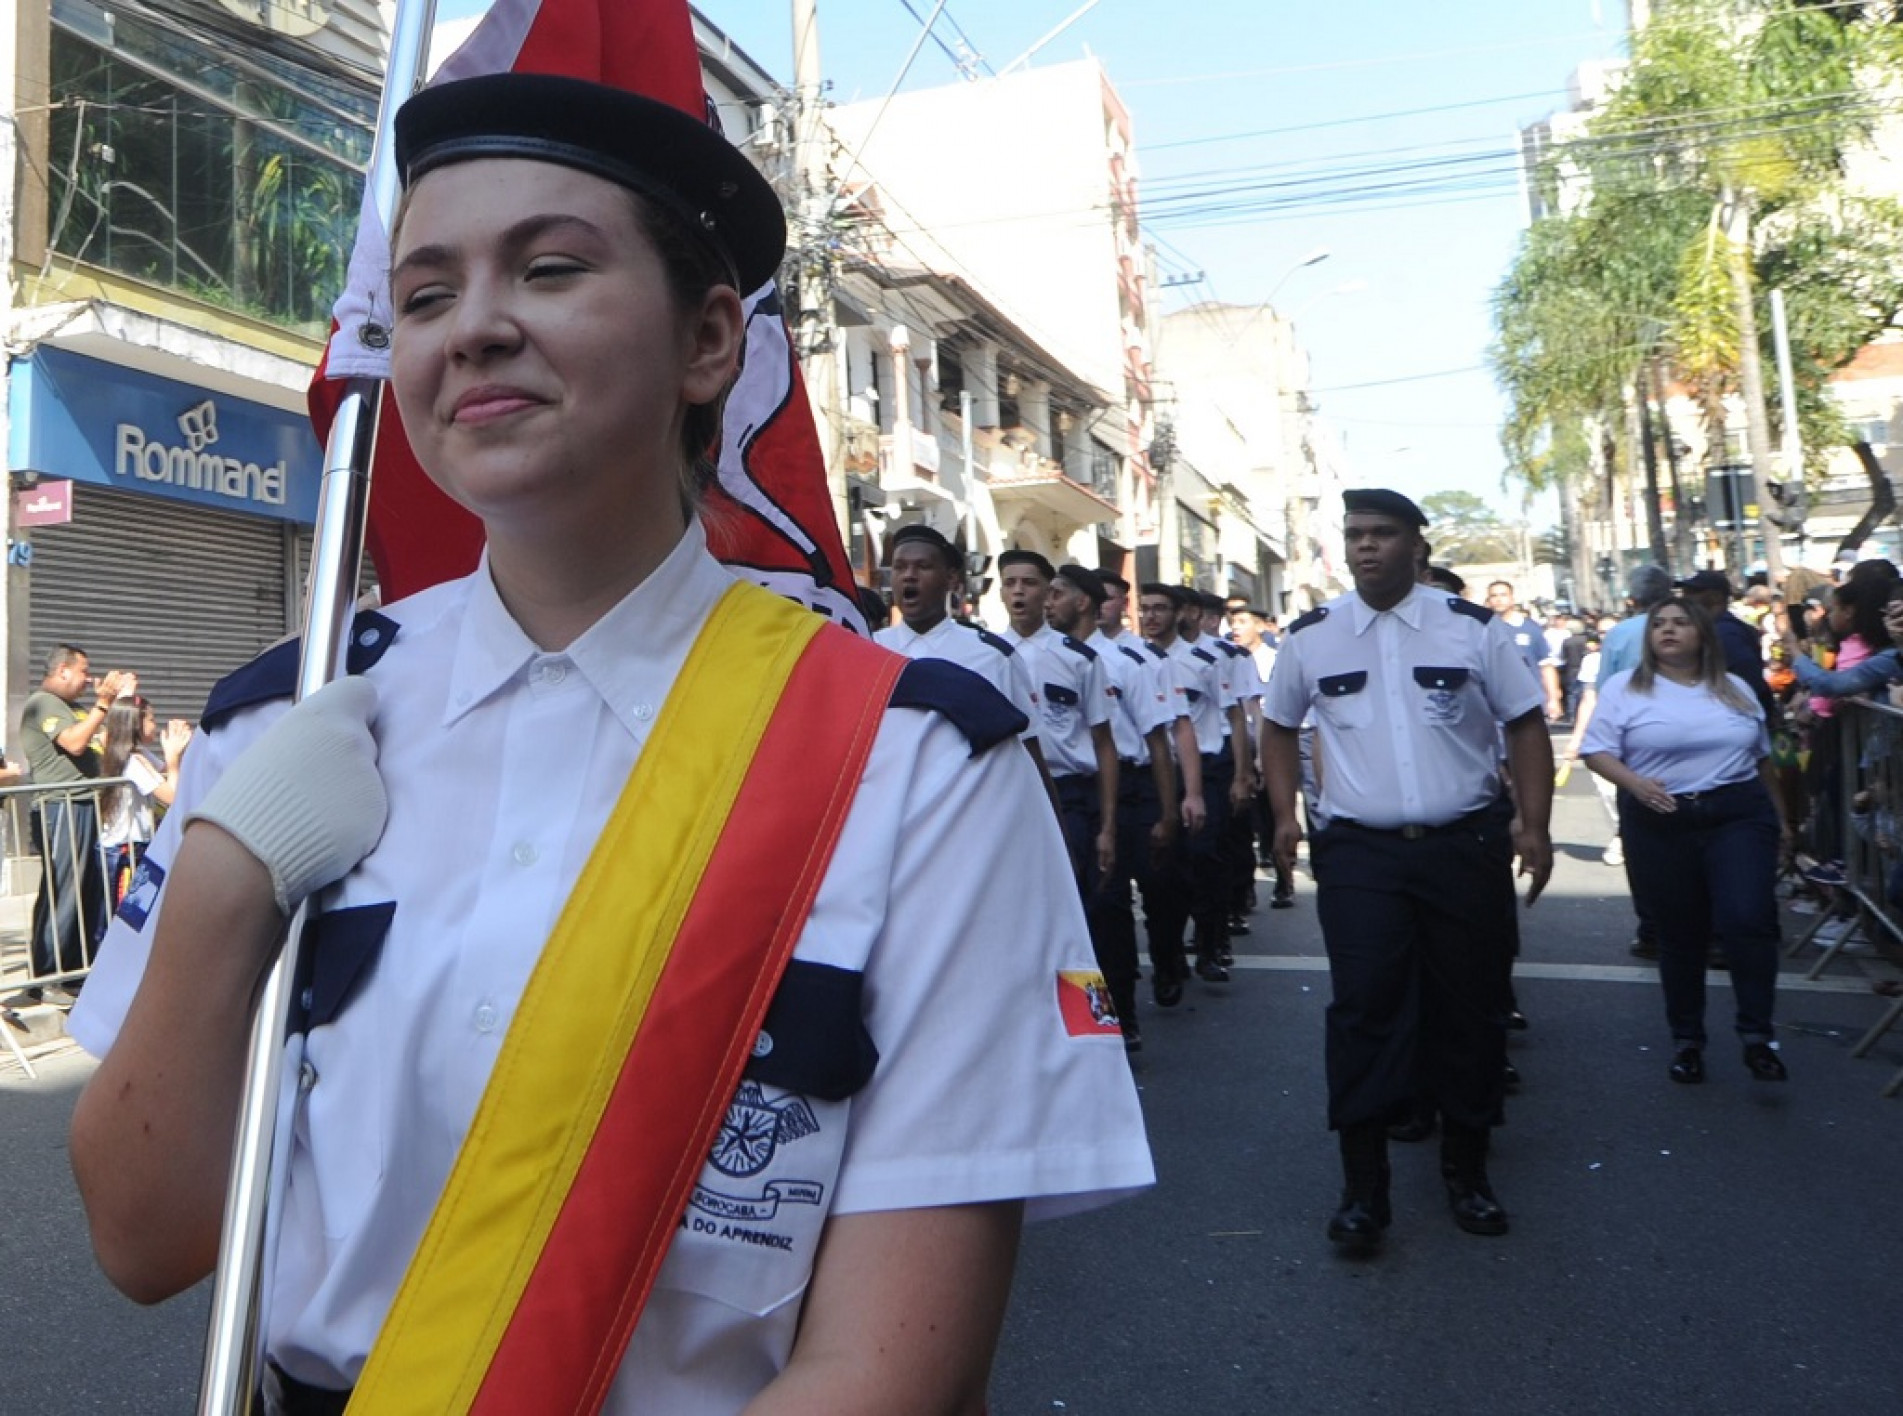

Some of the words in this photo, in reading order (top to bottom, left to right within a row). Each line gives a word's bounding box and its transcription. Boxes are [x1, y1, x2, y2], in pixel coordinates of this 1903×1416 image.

[115, 423, 287, 505] Rommanel
[693, 1218, 716, 1234] DO
[720, 1226, 793, 1251] APRENDIZ
